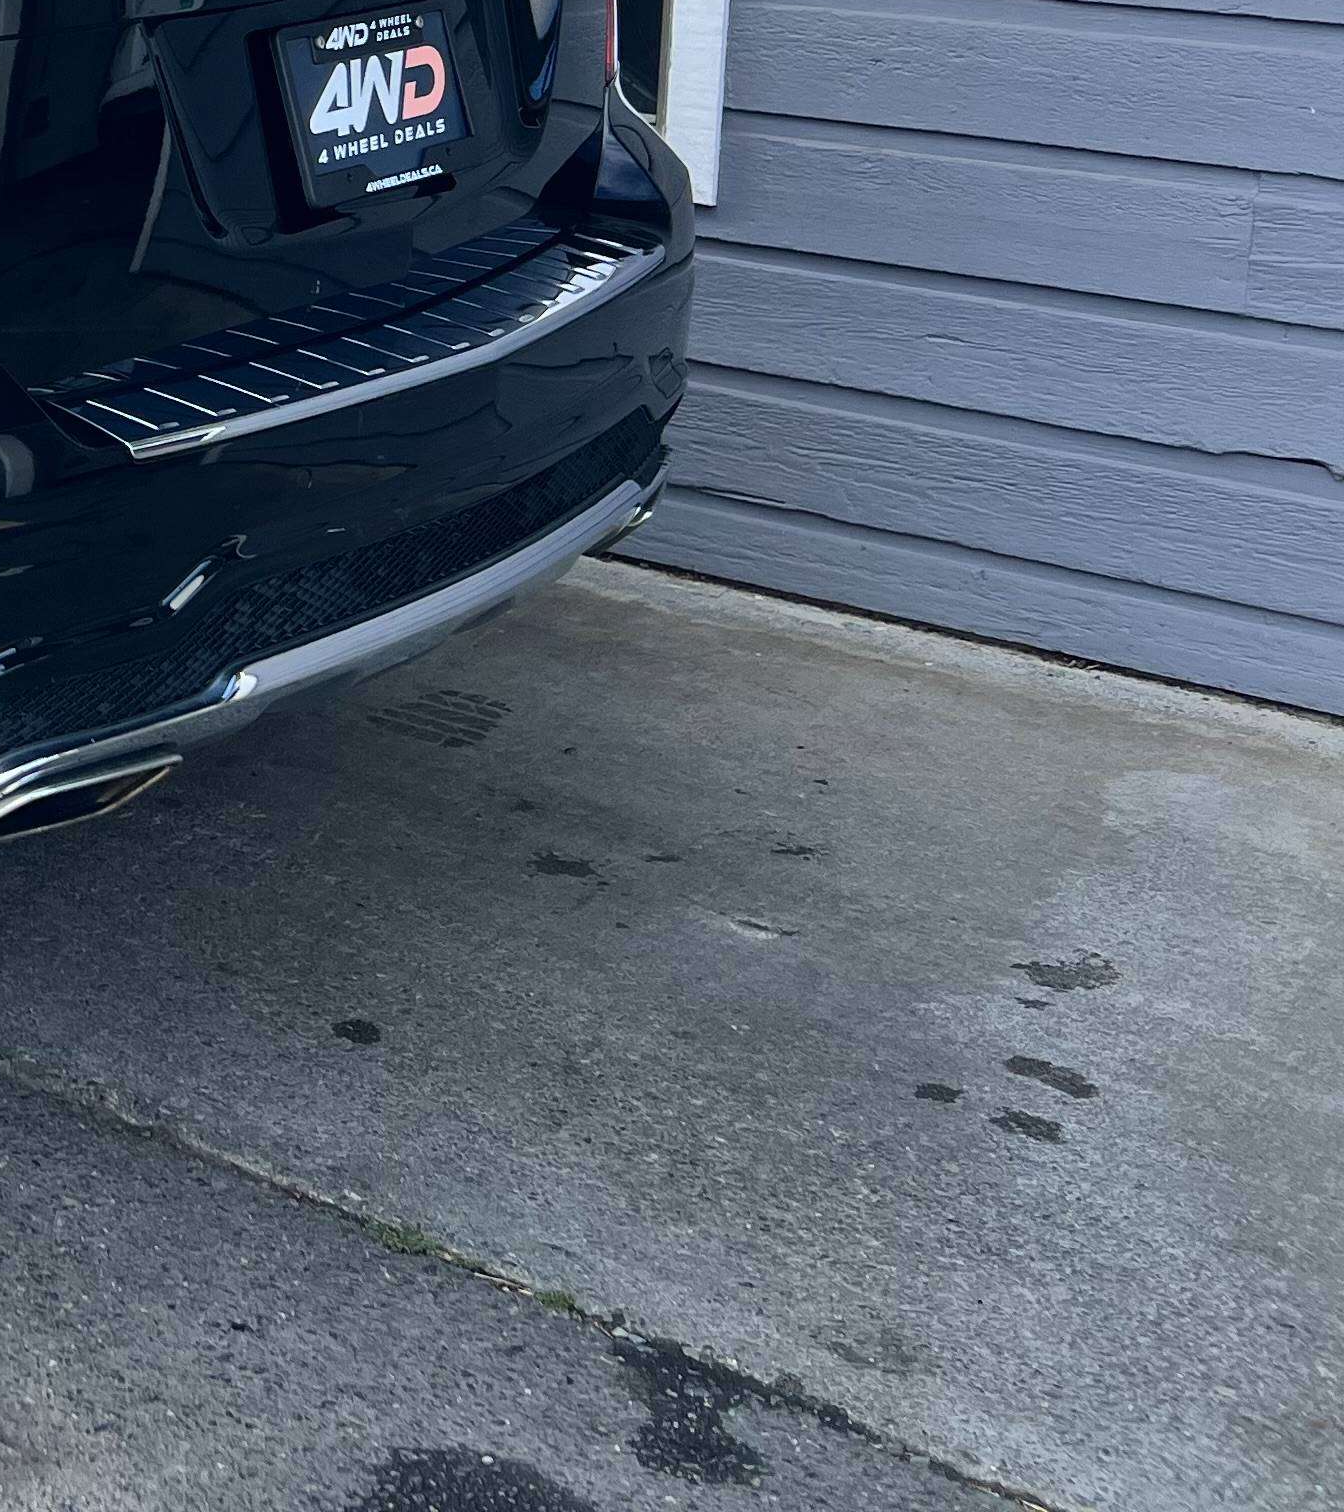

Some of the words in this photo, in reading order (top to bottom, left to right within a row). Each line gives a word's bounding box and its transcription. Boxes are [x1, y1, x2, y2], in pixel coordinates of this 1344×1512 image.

[326, 21, 369, 50] 4WD
[370, 17, 376, 30] 4
[379, 13, 412, 29] WHEEL
[376, 26, 410, 42] DEALS
[310, 45, 445, 137] 4WD
[318, 148, 329, 164] 4
[334, 136, 389, 161] WHEEL
[395, 118, 446, 145] DEALS
